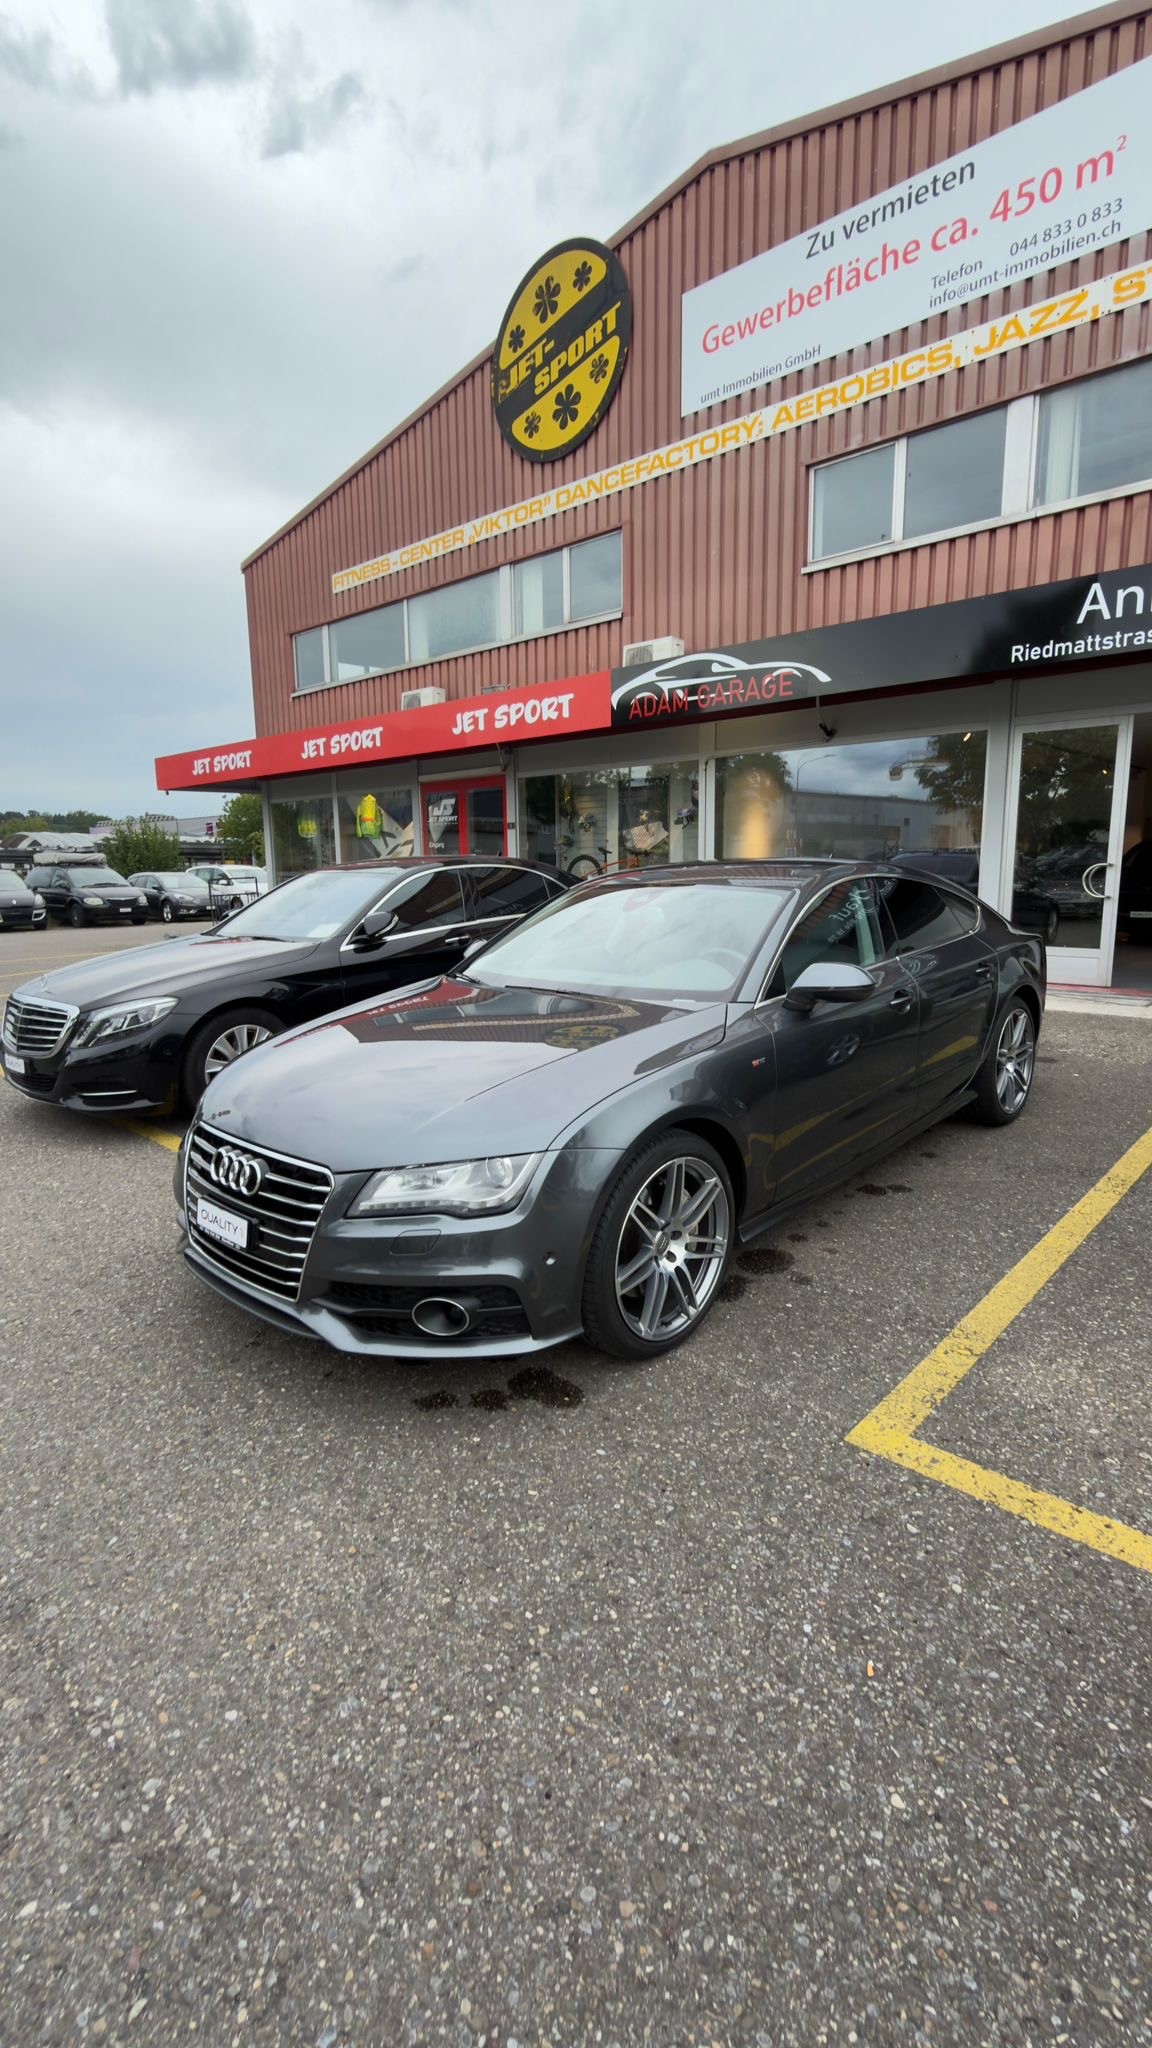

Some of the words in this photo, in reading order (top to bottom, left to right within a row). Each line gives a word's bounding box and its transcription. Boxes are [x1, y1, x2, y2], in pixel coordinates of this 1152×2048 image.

[806, 231, 835, 259] Zu
[842, 161, 976, 240] vermieten
[931, 260, 982, 289] Telefon
[1010, 234, 1038, 256] 044
[1042, 219, 1072, 242] 833
[1077, 213, 1087, 228] 0
[1091, 198, 1123, 222] 833
[702, 240, 921, 354] Gewerbefläche
[931, 216, 979, 253] ca.
[989, 167, 1063, 223] 450
[929, 220, 1121, 308] info@umt-immobilien.ch
[534, 301, 621, 395] SPORT
[700, 388, 720, 403] umt
[723, 363, 782, 395] Immobilien
[785, 344, 821, 369] GmbH
[556, 415, 764, 509] DANCEFACTORY:
[770, 342, 962, 431] AEROBICS,
[973, 289, 1100, 356] JAZZ,
[1113, 266, 1152, 304] S
[1076, 582, 1152, 624] An
[452, 708, 489, 735] JET
[494, 693, 575, 729] SPORT
[629, 690, 689, 720] ADAM
[697, 672, 794, 709] GARAGE
[192, 757, 211, 776] JET
[213, 750, 252, 773] SPORT
[301, 737, 326, 760] JET
[330, 726, 384, 755] SPORT
